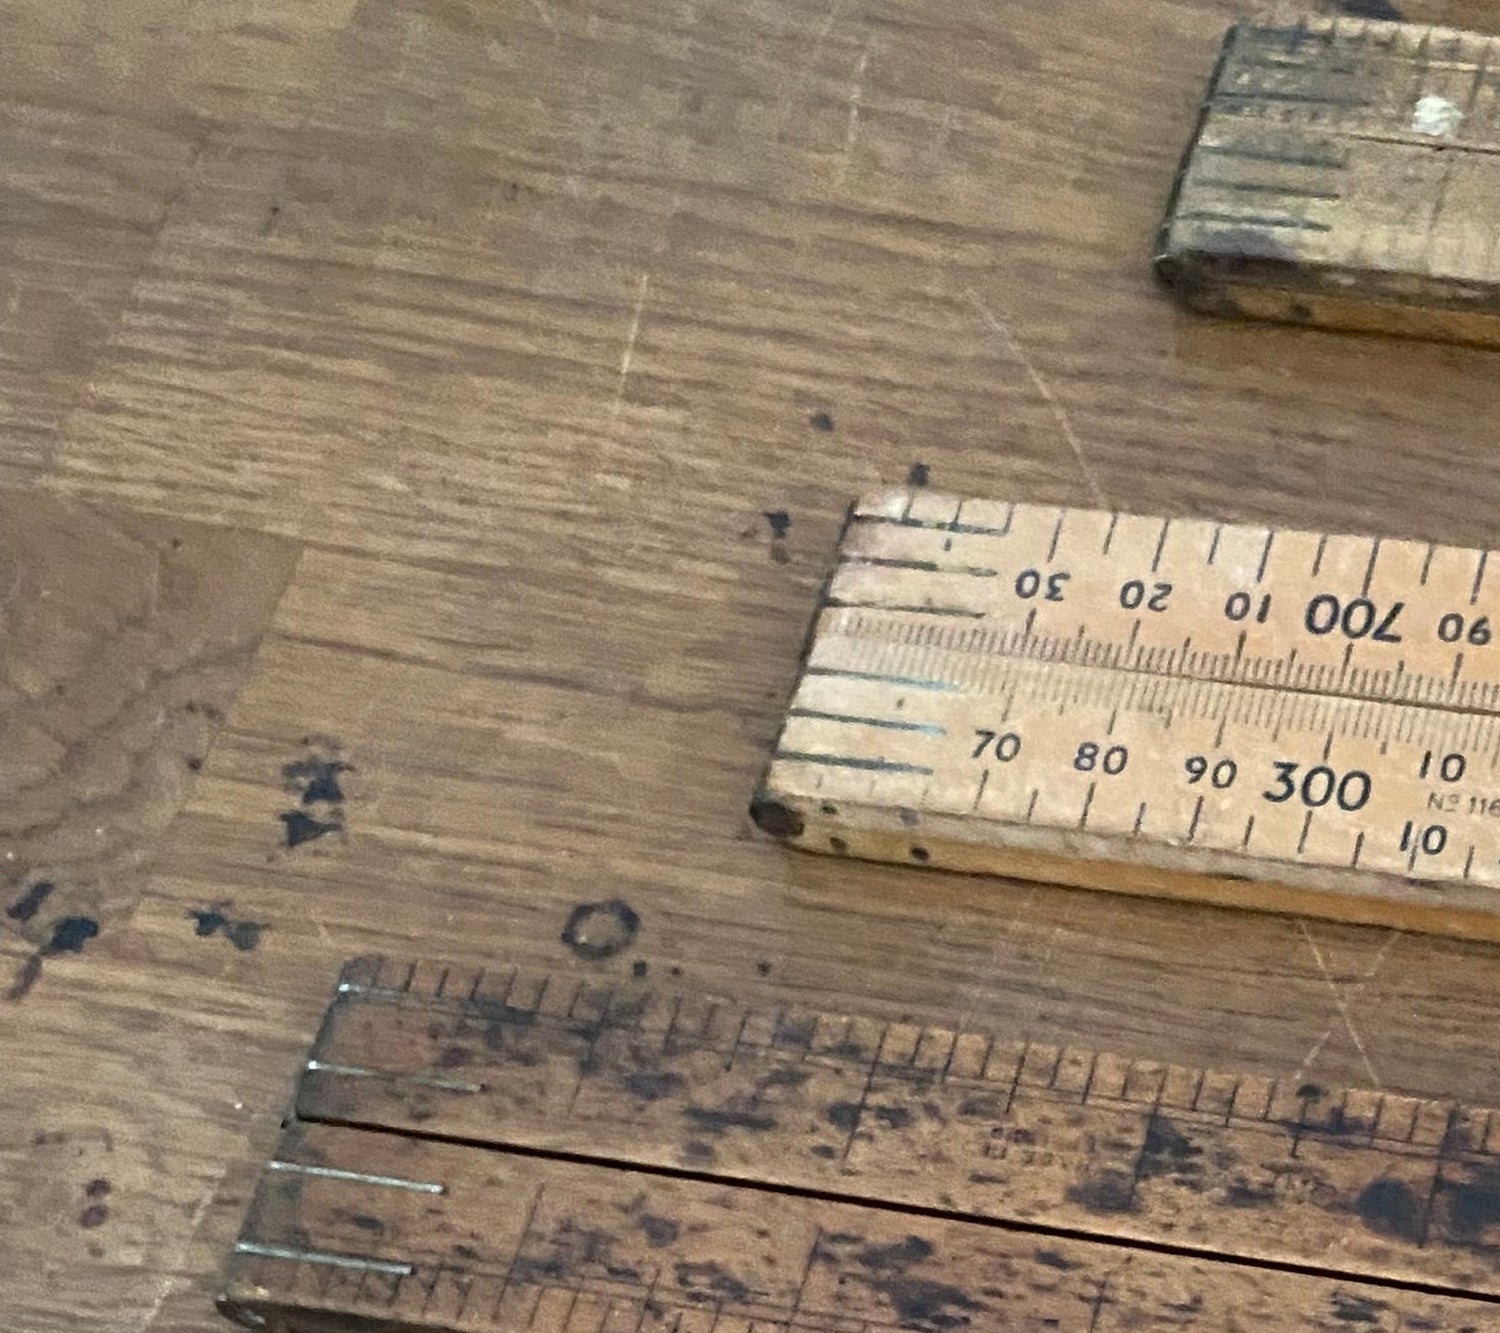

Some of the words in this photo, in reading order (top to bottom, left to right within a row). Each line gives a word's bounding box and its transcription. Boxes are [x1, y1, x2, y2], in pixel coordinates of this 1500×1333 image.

[1015, 568, 1072, 602] 30
[1120, 579, 1173, 613] 20
[1225, 591, 1272, 624] 10
[1304, 593, 1405, 643] 700
[1437, 613, 1493, 647] 90
[1418, 750, 1467, 783] 10
[971, 729, 1022, 763] 70
[1073, 741, 1129, 775] 80
[1183, 755, 1238, 789] 90
[1262, 760, 1372, 812] 300
[1400, 820, 1448, 856] 10
